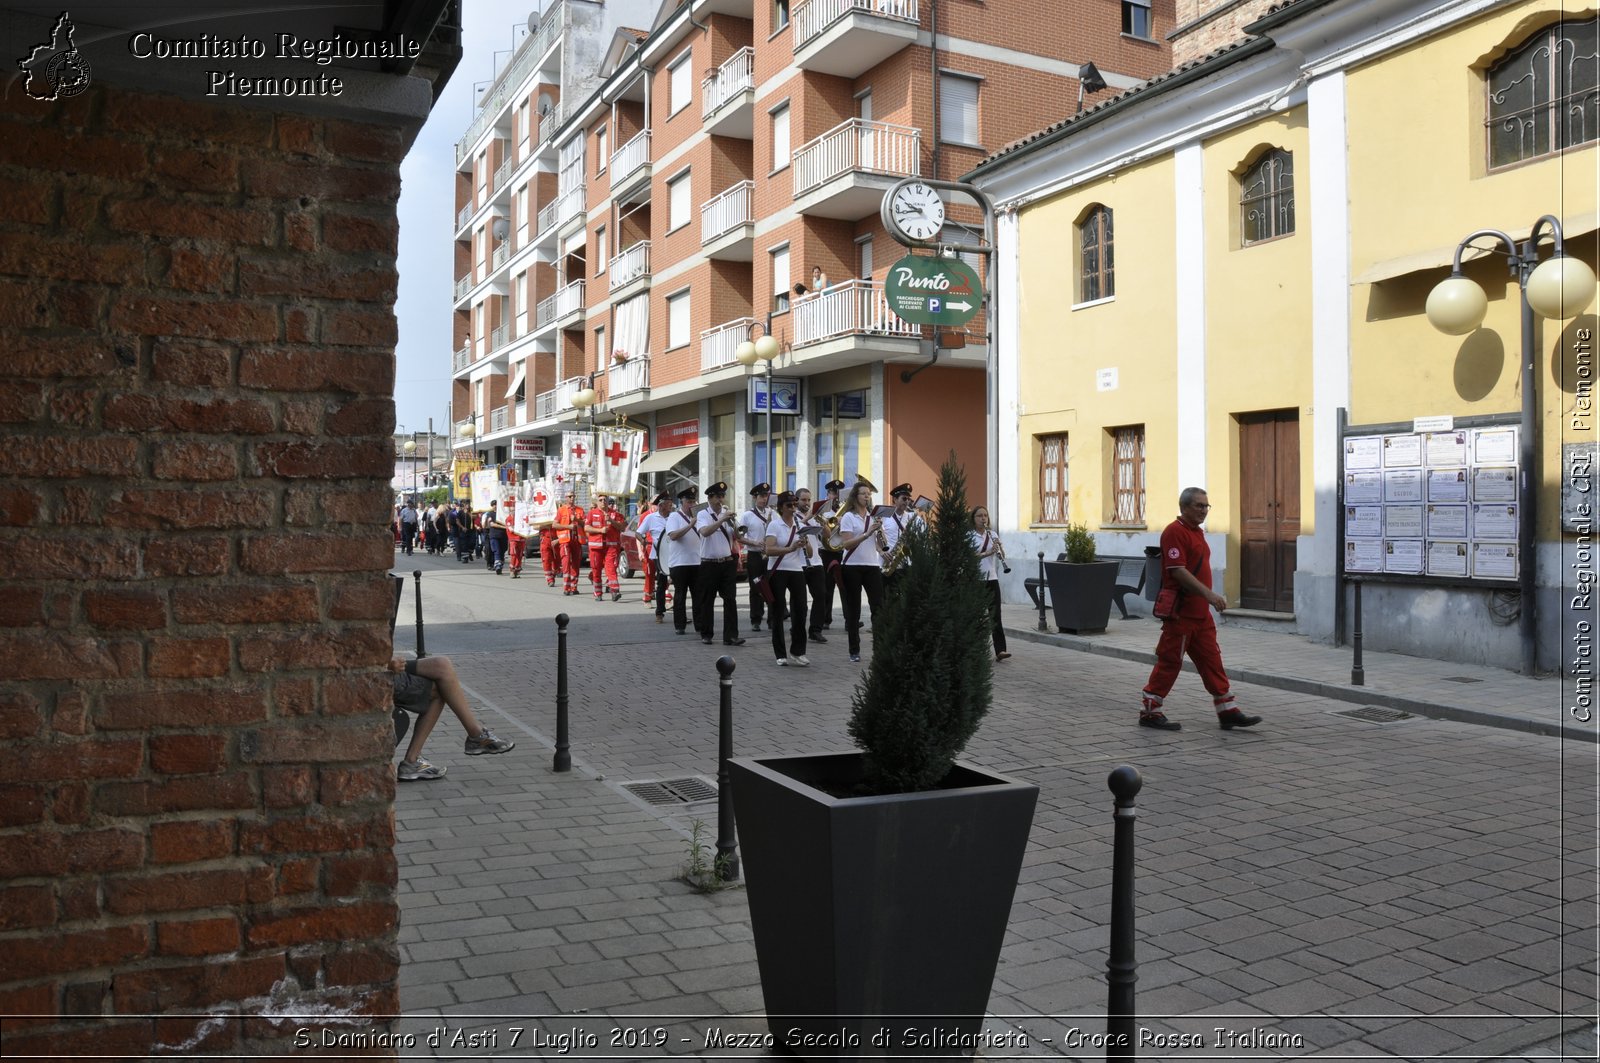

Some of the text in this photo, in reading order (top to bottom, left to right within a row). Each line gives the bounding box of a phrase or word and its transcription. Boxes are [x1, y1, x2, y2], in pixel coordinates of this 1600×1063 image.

[915, 184, 923, 195] 12
[895, 203, 900, 214] 9
[938, 208, 943, 219] 3
[917, 227, 922, 238] 6
[895, 267, 950, 290] Punto
[929, 299, 939, 311] P
